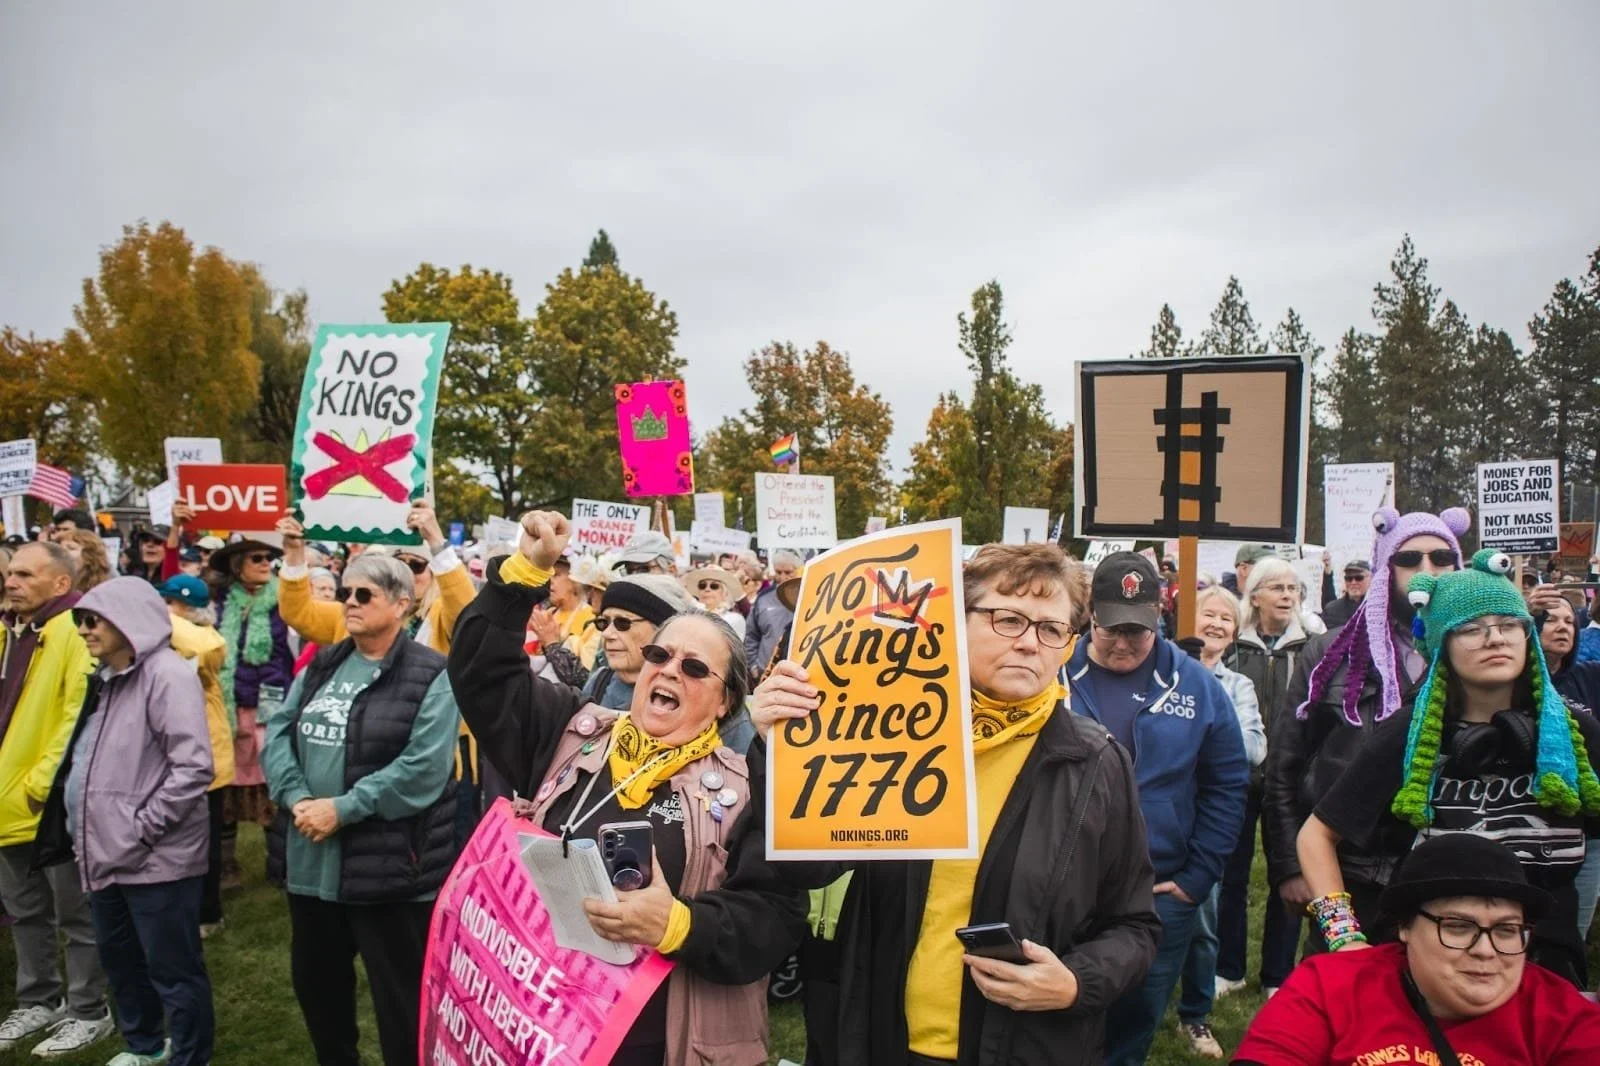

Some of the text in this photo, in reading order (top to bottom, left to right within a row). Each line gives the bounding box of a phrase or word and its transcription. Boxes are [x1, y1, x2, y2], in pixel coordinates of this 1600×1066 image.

[336, 349, 398, 379] NO
[316, 376, 416, 426] KINGS
[1484, 465, 1553, 479] MONEY FOR
[1484, 477, 1553, 493] JOBS AND
[186, 484, 279, 512] LOVE
[1483, 490, 1553, 504] EDUCATION,
[576, 503, 641, 521] THE ONLY
[1484, 511, 1553, 527] NOT MASS
[590, 520, 637, 533] ORANGE
[1484, 525, 1554, 537] DEPORTATION!
[577, 527, 633, 549] MONAR
[1101, 542, 1122, 554] NO
[804, 543, 919, 622] No
[799, 616, 950, 688] Kings
[1156, 702, 1196, 719] OOD
[1182, 695, 1196, 707] IS
[783, 682, 949, 748] Since
[789, 744, 949, 820] 1776
[830, 829, 909, 842] NOKINGS.ORG
[460, 894, 565, 1013] INDIVISIBLE,
[449, 941, 567, 1066] WITH LIBERTY
[438, 991, 466, 1042] AND
